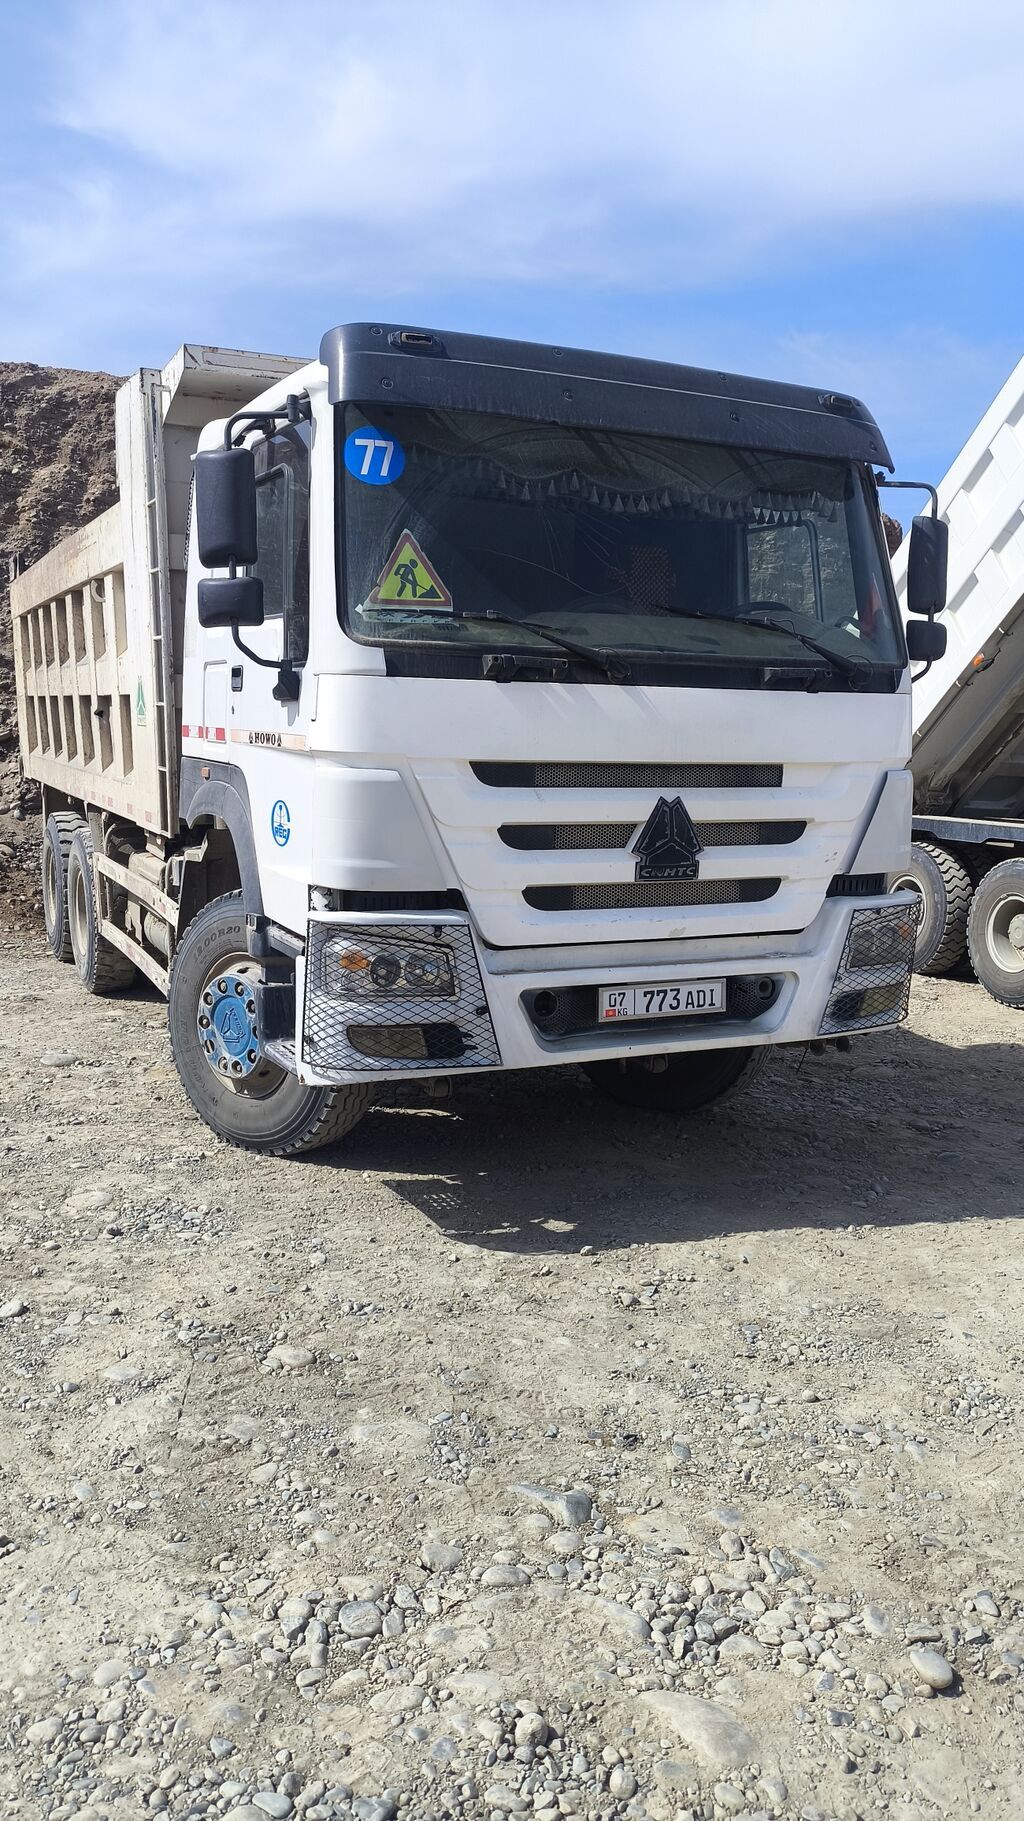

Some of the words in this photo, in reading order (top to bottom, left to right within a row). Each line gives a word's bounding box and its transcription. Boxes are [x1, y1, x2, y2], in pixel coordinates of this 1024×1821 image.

[355, 438, 394, 476] 77
[254, 732, 276, 746] HOWO
[608, 992, 626, 1008] 07
[643, 988, 681, 1013] 773
[685, 989, 716, 1009] ADI
[617, 1008, 628, 1016] KG
